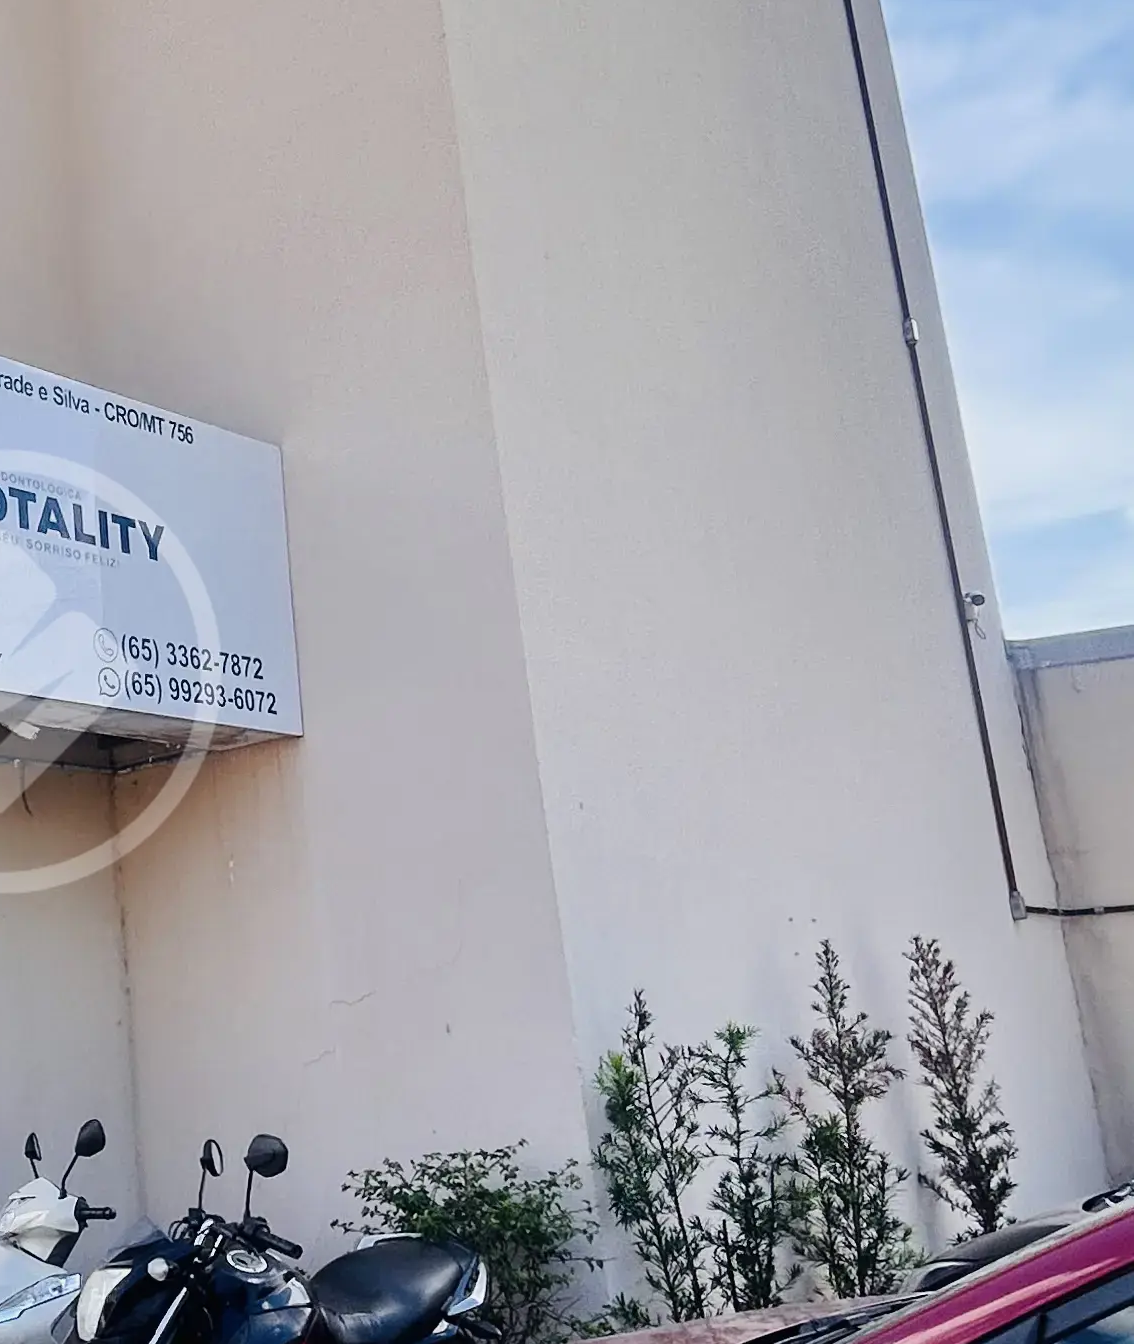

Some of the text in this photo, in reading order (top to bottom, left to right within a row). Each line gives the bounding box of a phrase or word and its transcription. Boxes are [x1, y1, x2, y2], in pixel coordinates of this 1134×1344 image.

[39, 385, 48, 401] e
[53, 385, 90, 415] Silva
[104, 401, 165, 436] CRO/MT
[169, 420, 194, 445] 756
[25, 537, 82, 561] SORRISO
[121, 634, 264, 680] (65) 3362-7872
[124, 669, 278, 715] (65) 99293-6072
